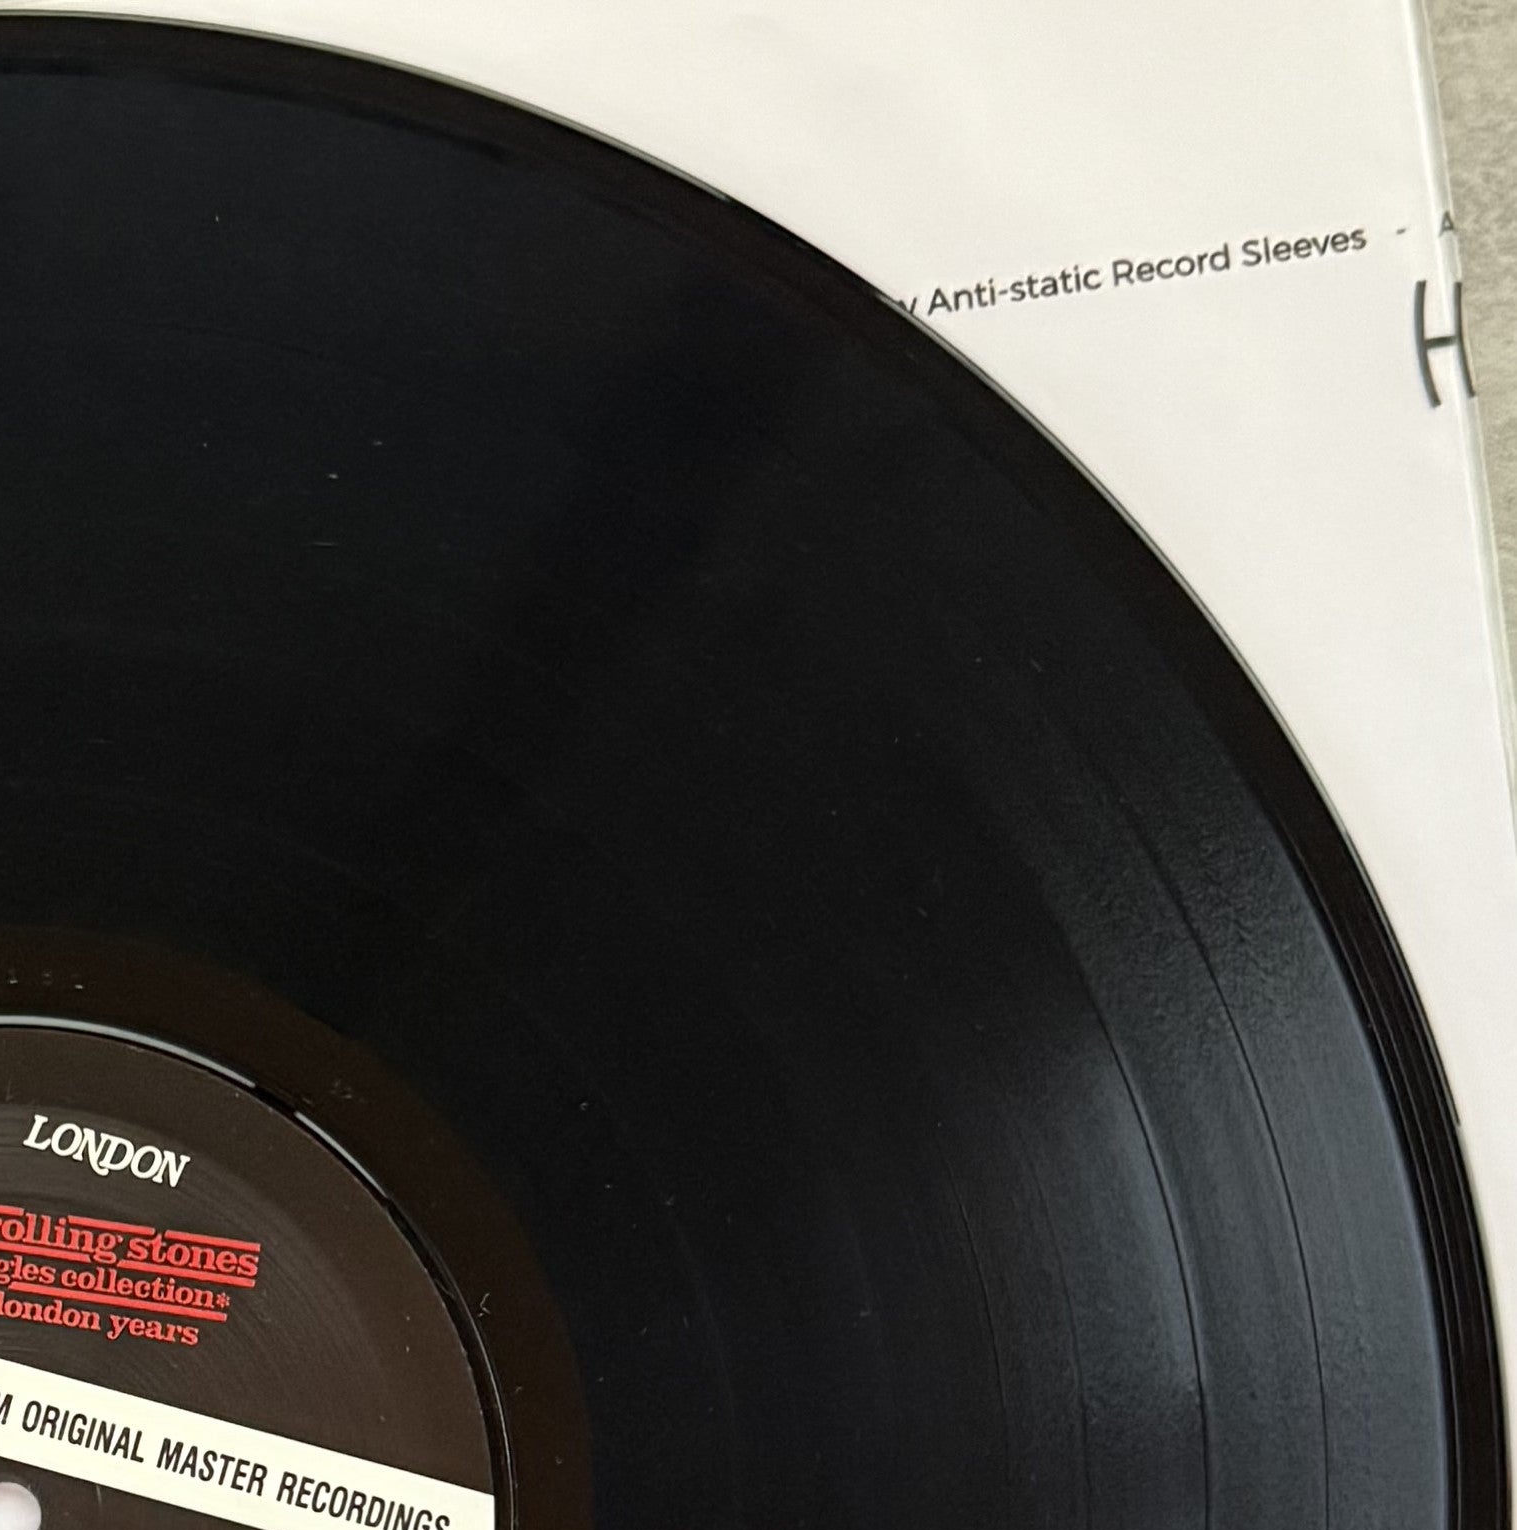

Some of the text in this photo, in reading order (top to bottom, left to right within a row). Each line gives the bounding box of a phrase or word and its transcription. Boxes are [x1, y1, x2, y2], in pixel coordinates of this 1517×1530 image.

[928, 266, 1102, 315] Anti-static
[1113, 243, 1232, 287] Record
[1241, 226, 1368, 266] Sleeves
[23, 1114, 190, 1188] LONDON
[127, 1230, 259, 1278] stones
[107, 1314, 199, 1346] years
[21, 1399, 144, 1463] ORIGINAL
[155, 1437, 268, 1496] MASTER
